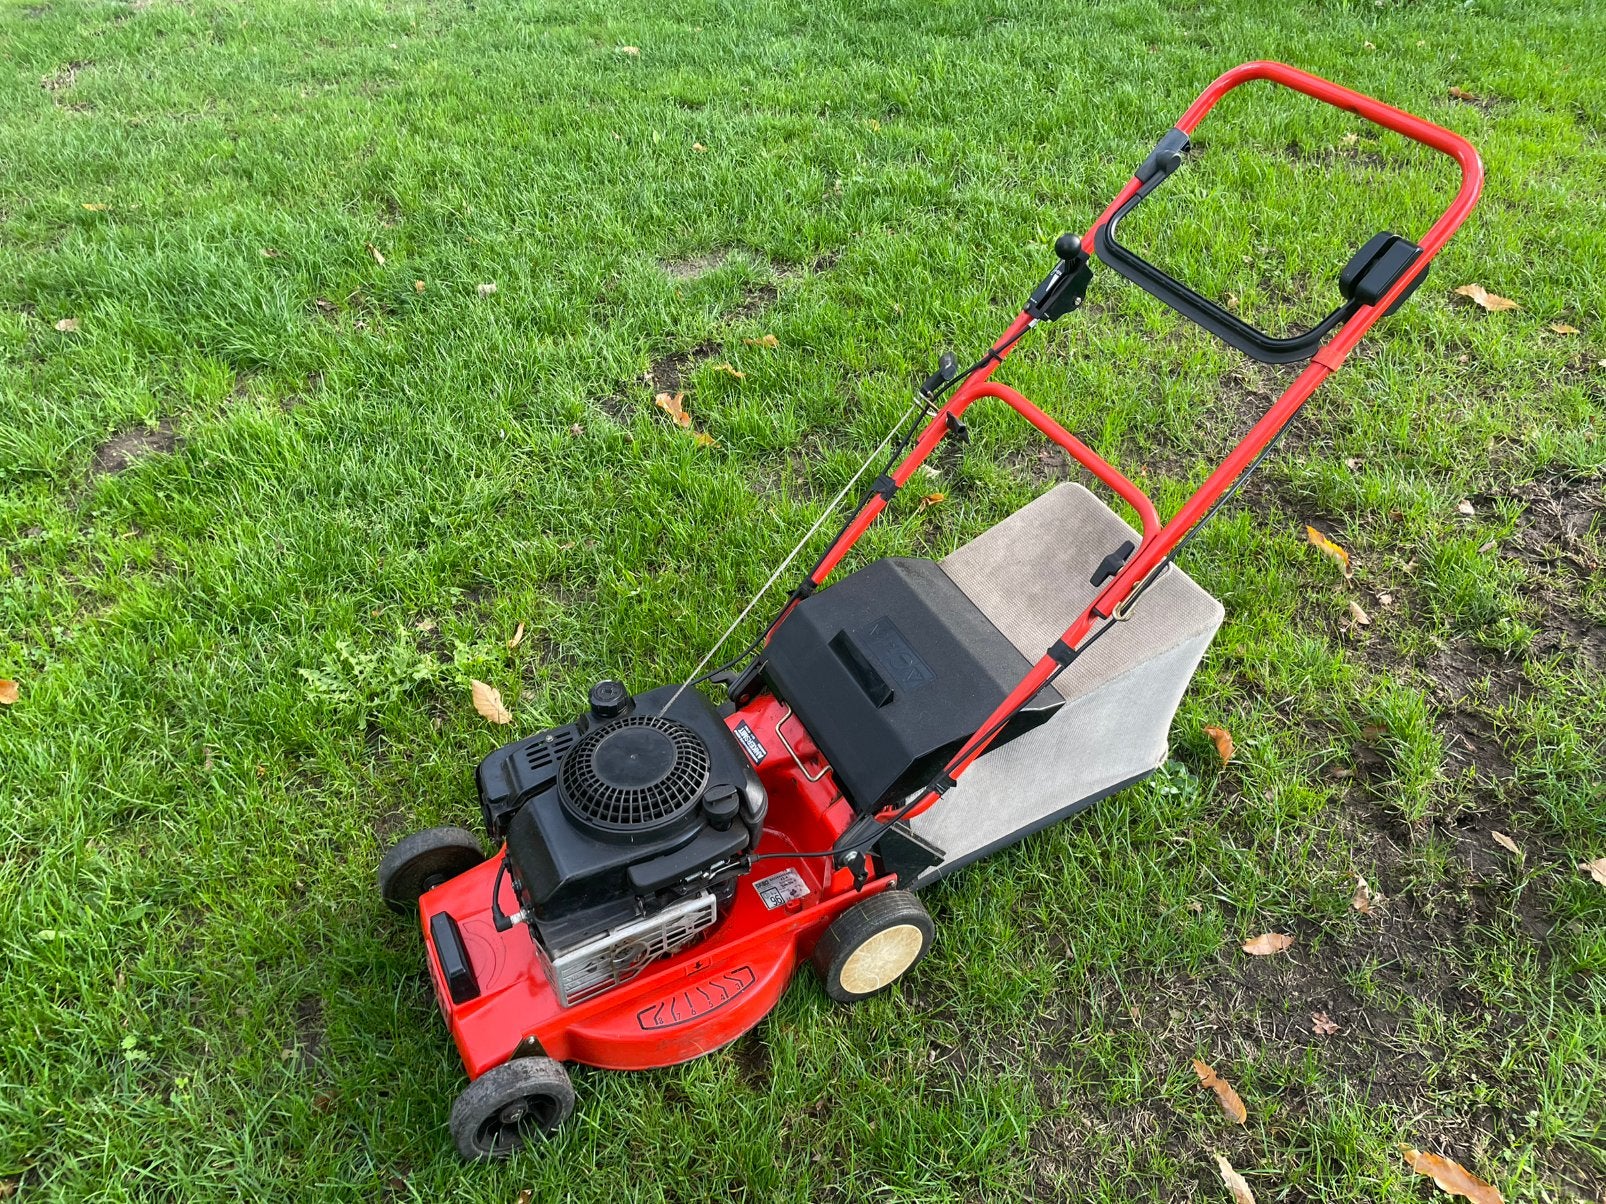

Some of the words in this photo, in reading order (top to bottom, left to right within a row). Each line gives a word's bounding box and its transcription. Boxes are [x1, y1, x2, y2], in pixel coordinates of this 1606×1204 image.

[738, 727, 764, 759] ANKERSMIT
[770, 894, 783, 906] 96
[658, 1017, 664, 1025] 8
[676, 1012, 681, 1020] 7
[720, 993, 726, 1001] 4
[735, 982, 741, 990] 3
